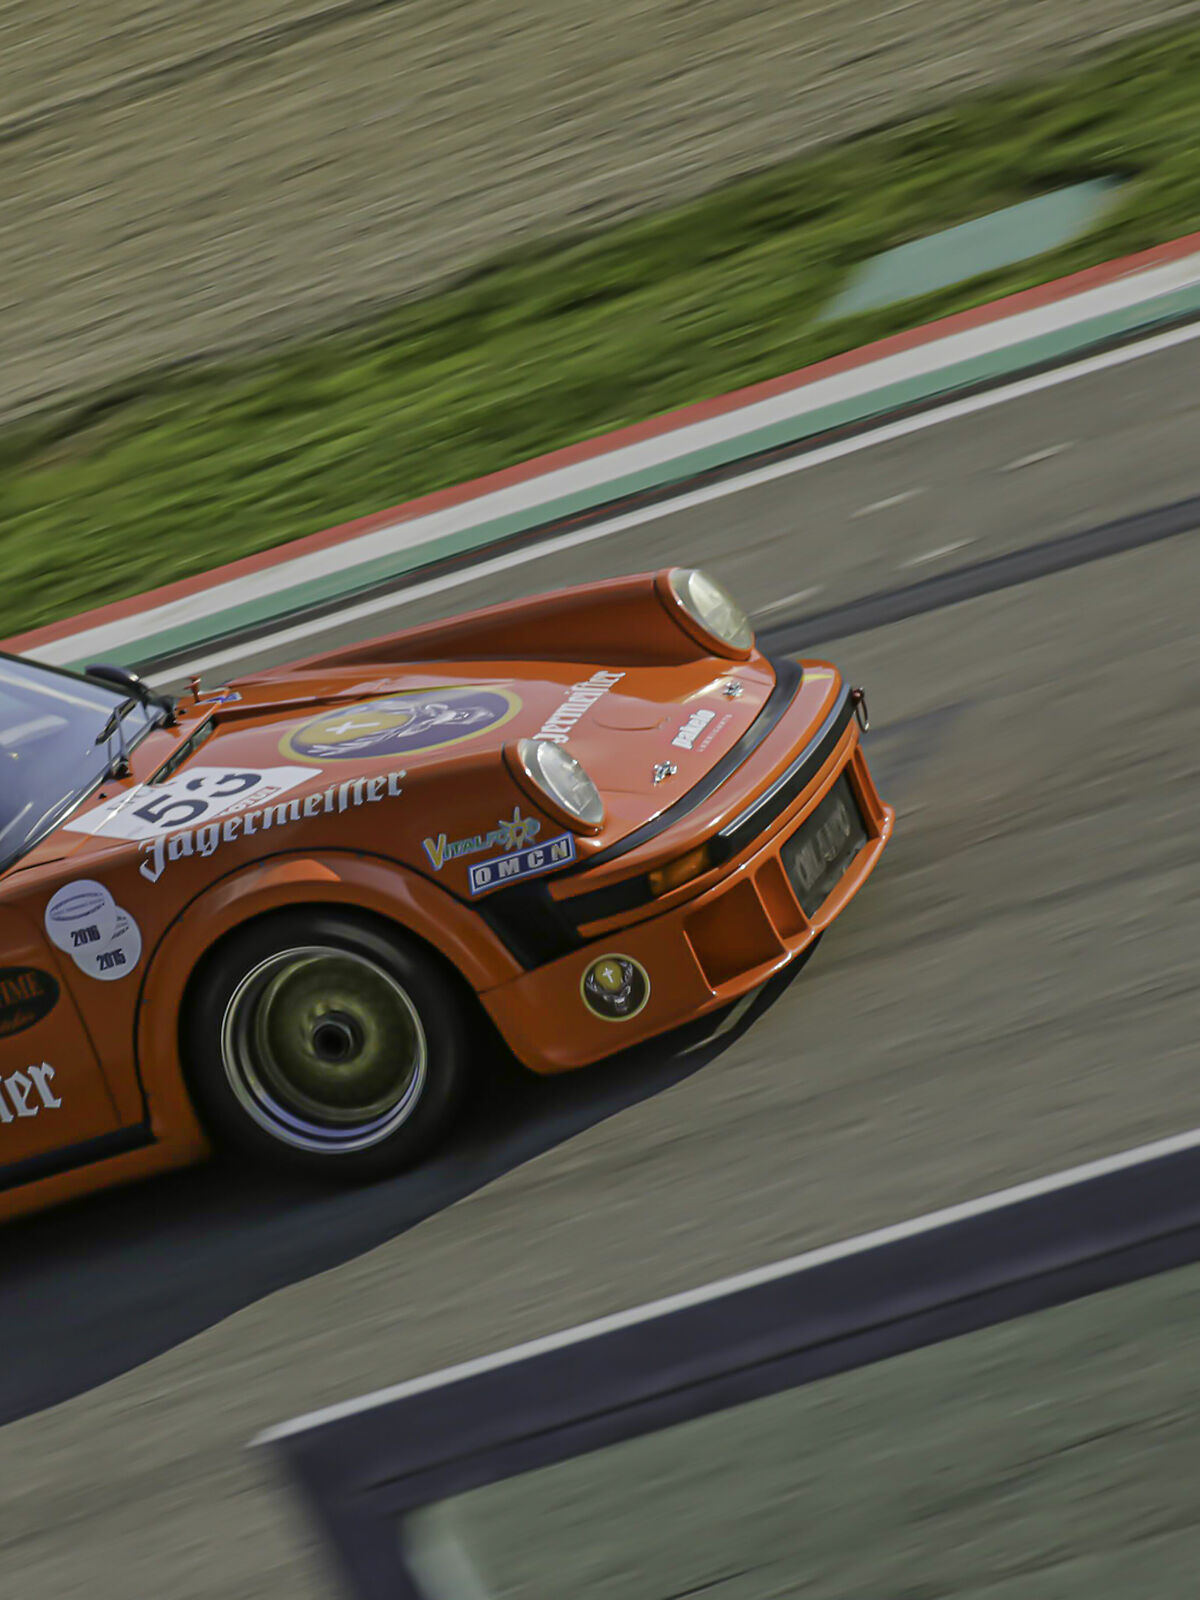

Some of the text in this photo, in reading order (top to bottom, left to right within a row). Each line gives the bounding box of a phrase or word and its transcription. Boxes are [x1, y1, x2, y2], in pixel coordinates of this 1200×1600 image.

[133, 772, 263, 828] 53
[475, 840, 568, 886] OMCN
[96, 948, 127, 971] 2015
